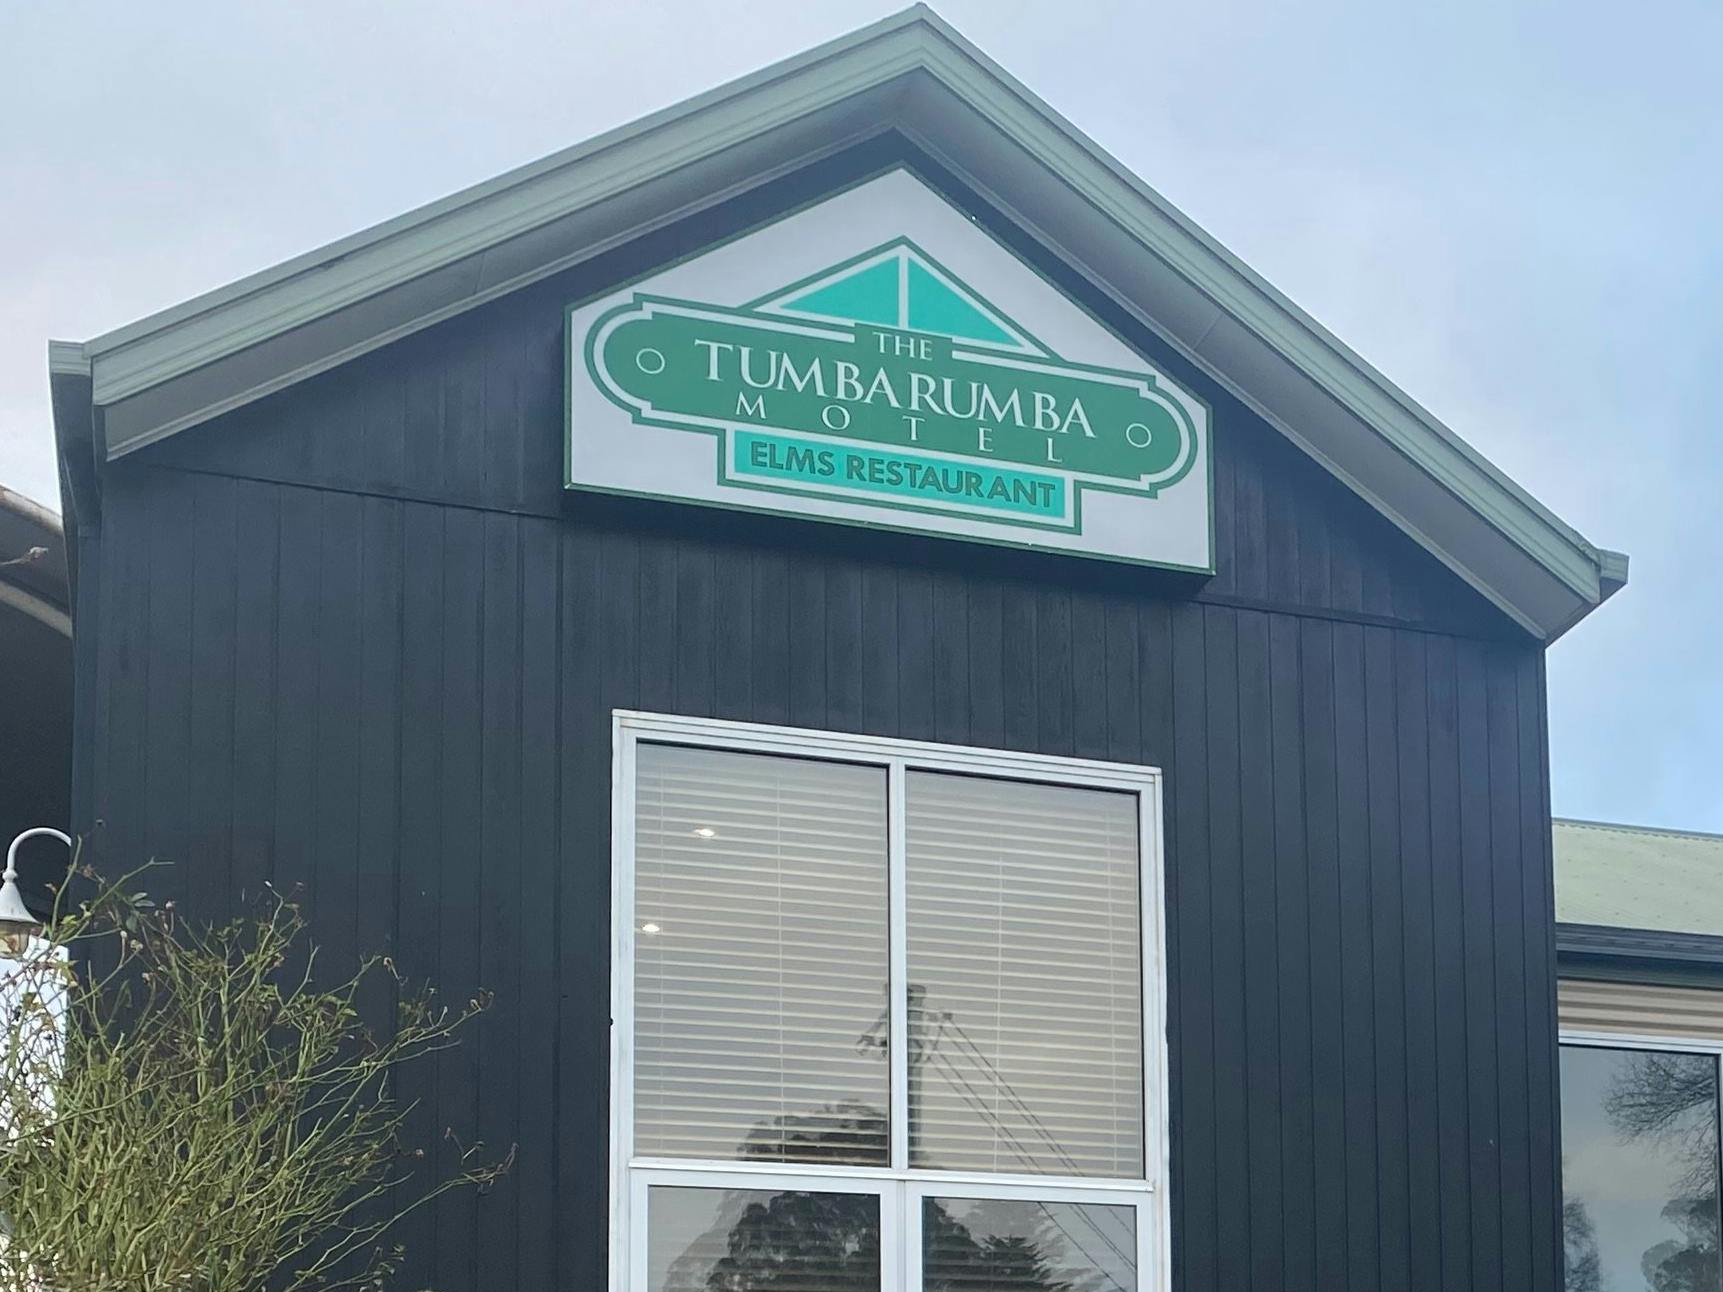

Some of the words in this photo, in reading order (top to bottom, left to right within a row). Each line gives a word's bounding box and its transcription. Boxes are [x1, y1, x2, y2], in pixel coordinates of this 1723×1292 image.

[871, 331, 933, 361] THE
[694, 338, 1097, 439] TUMBARUMBA
[735, 391, 1063, 463] MOTEL
[751, 440, 836, 476] ELMS
[846, 454, 1056, 508] RESTAURANT
